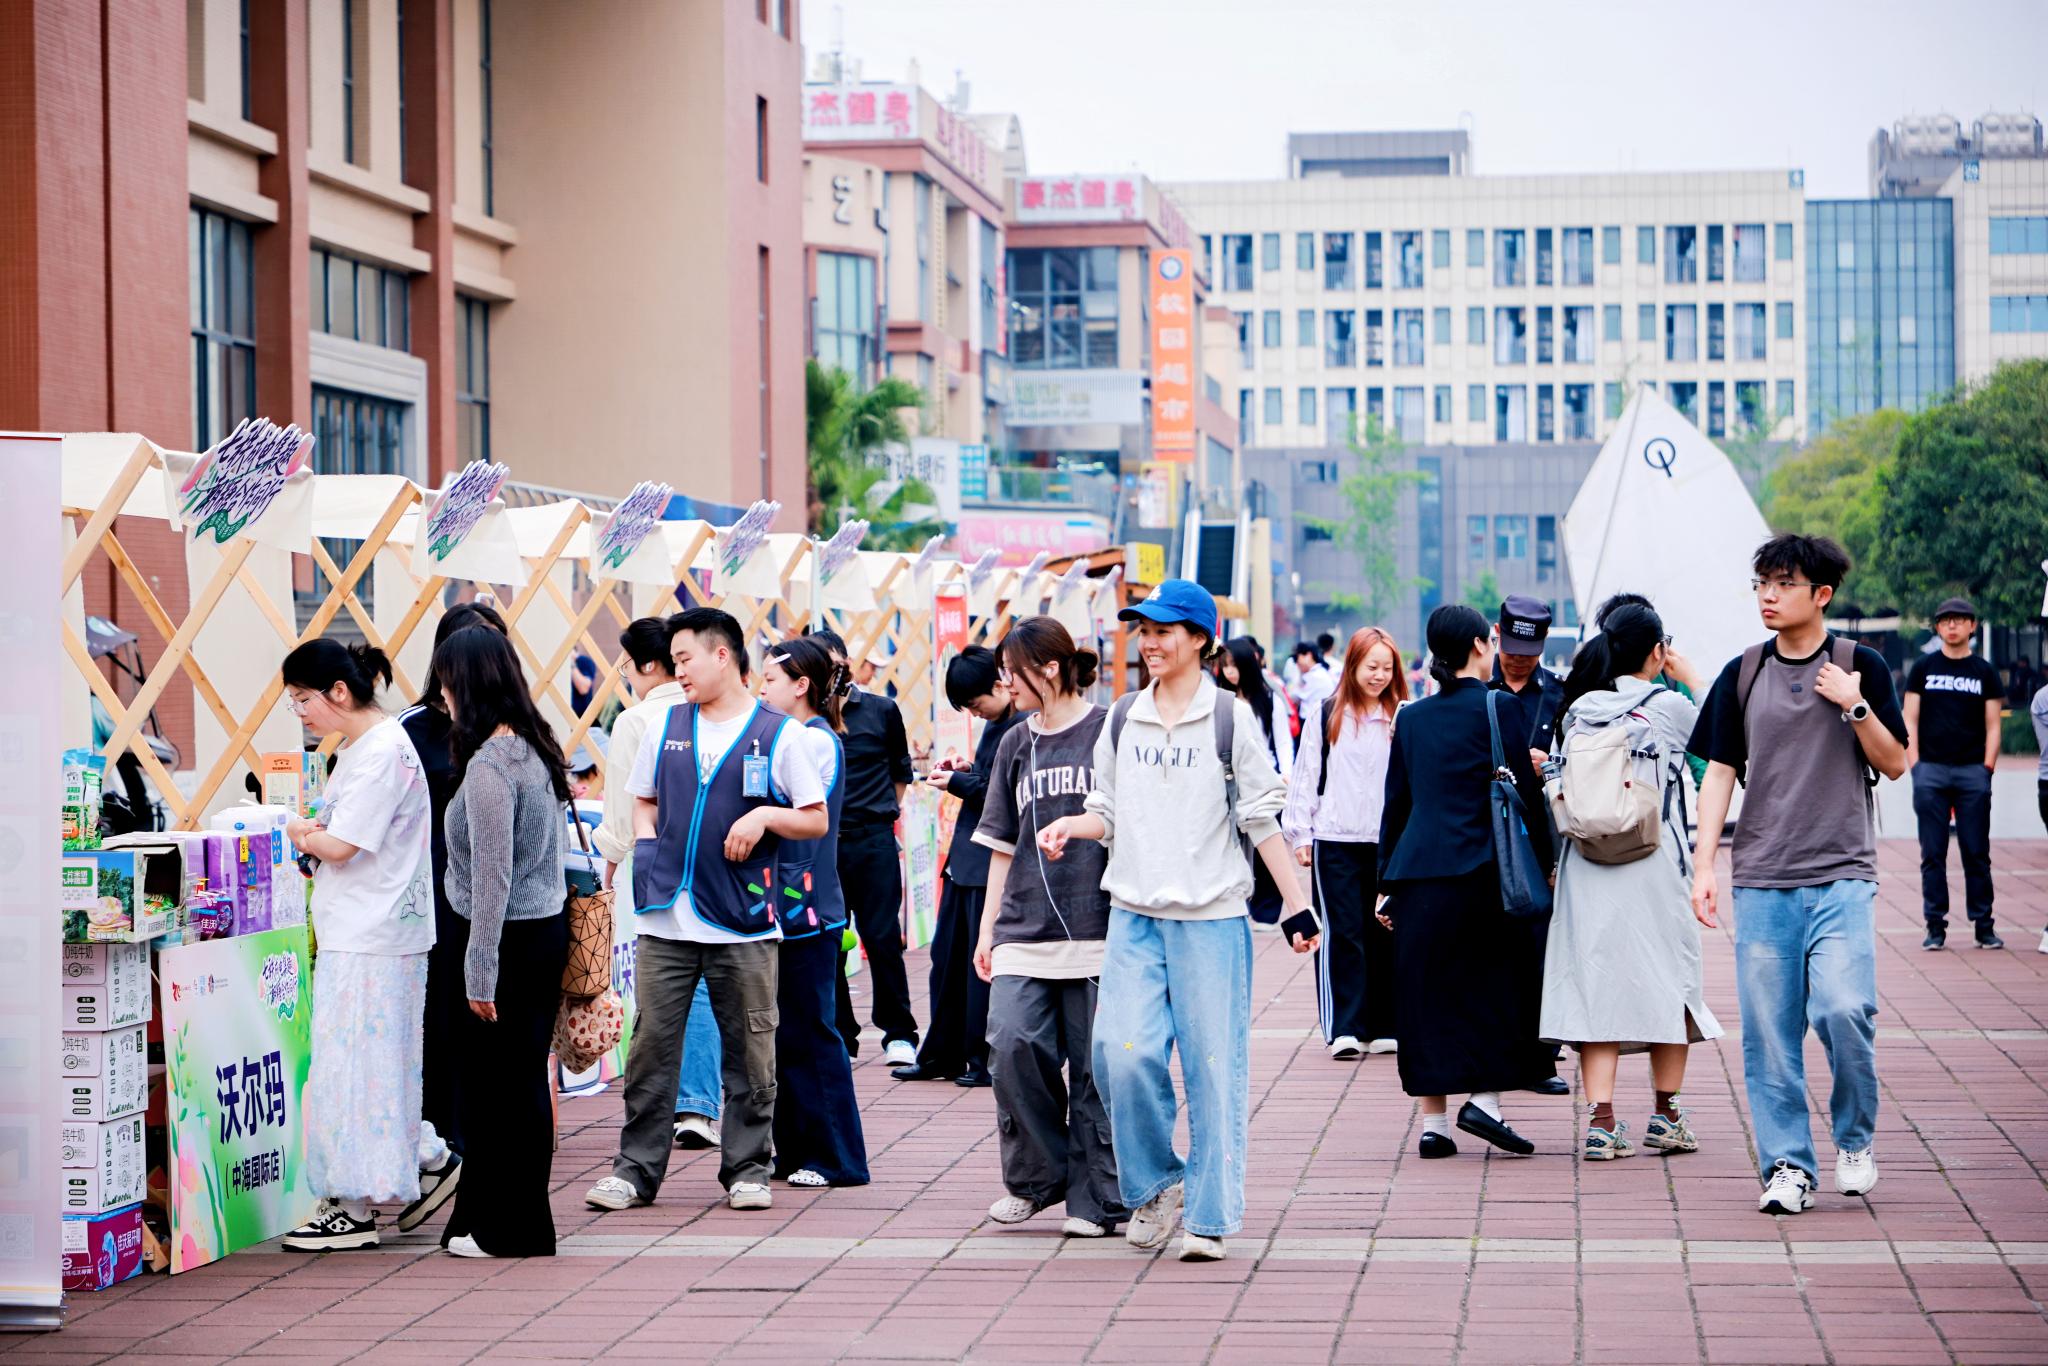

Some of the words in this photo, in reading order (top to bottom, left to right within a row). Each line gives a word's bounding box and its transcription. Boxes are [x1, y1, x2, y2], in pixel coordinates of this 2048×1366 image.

[1925, 675, 1982, 695] ZZEGNA
[1135, 746, 1200, 767] VOGUE
[216, 1050, 286, 1145] 沃尔玛
